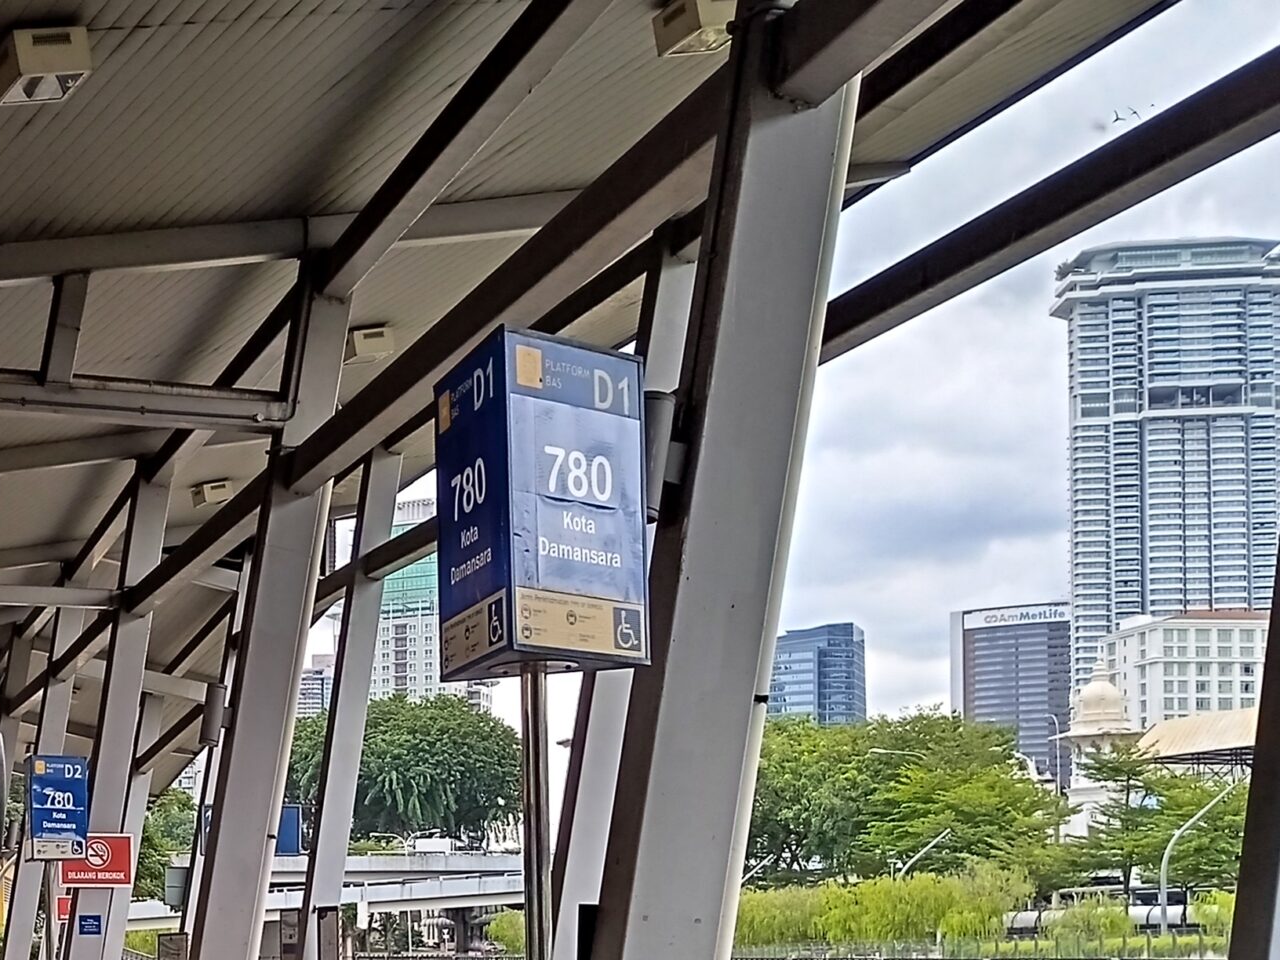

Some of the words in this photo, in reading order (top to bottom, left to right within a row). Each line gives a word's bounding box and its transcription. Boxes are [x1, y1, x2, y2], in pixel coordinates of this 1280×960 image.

[473, 355, 494, 412] D1
[545, 375, 562, 389] BAS
[545, 359, 590, 378] PLATFORM
[593, 367, 630, 416] D1
[543, 444, 613, 502] 780
[450, 456, 486, 522] 780
[460, 524, 480, 550] Kota
[562, 510, 596, 535] Kota
[450, 546, 493, 586] Damansara
[539, 536, 622, 568] Damansara
[999, 608, 1065, 623] AmMetLife
[64, 763, 83, 780] D2
[45, 790, 74, 809] 780
